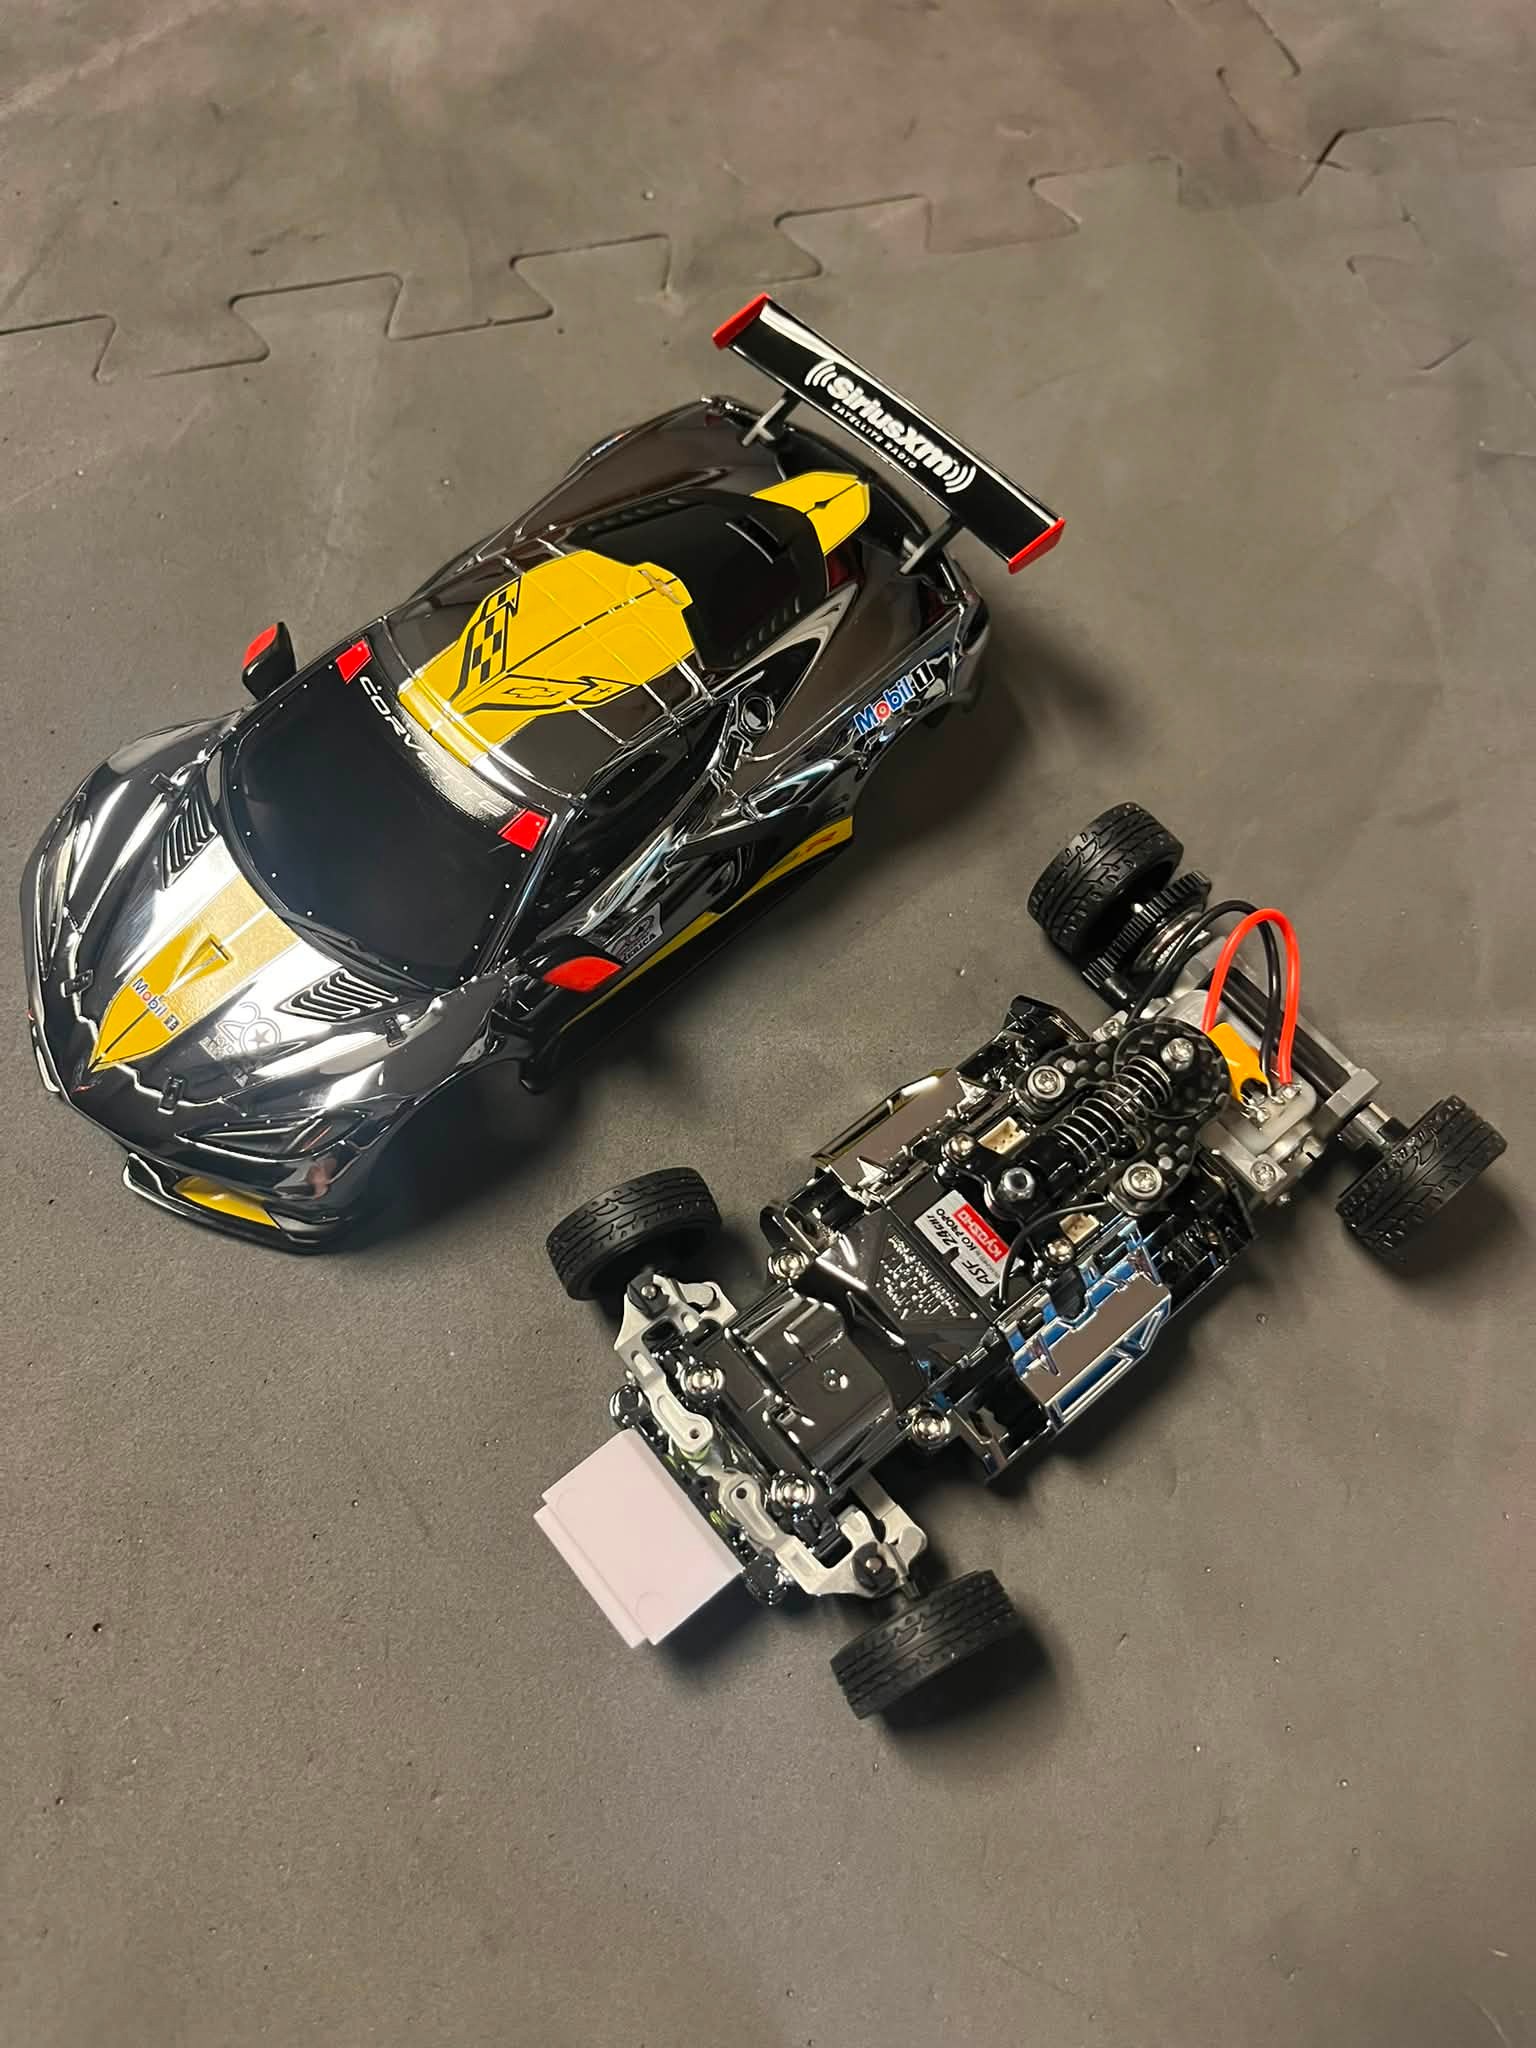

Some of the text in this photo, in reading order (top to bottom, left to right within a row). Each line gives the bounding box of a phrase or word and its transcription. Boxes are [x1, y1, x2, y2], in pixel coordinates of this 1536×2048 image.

[831, 403, 918, 469] SATELLITE RADIO
[853, 675, 916, 735] Mobil
[359, 676, 507, 818] CORVETTE
[131, 976, 168, 1017] Mobil
[935, 1208, 977, 1251] KO PROPO
[956, 1209, 1003, 1259] KYOSHO
[961, 1260, 994, 1285] ASF
